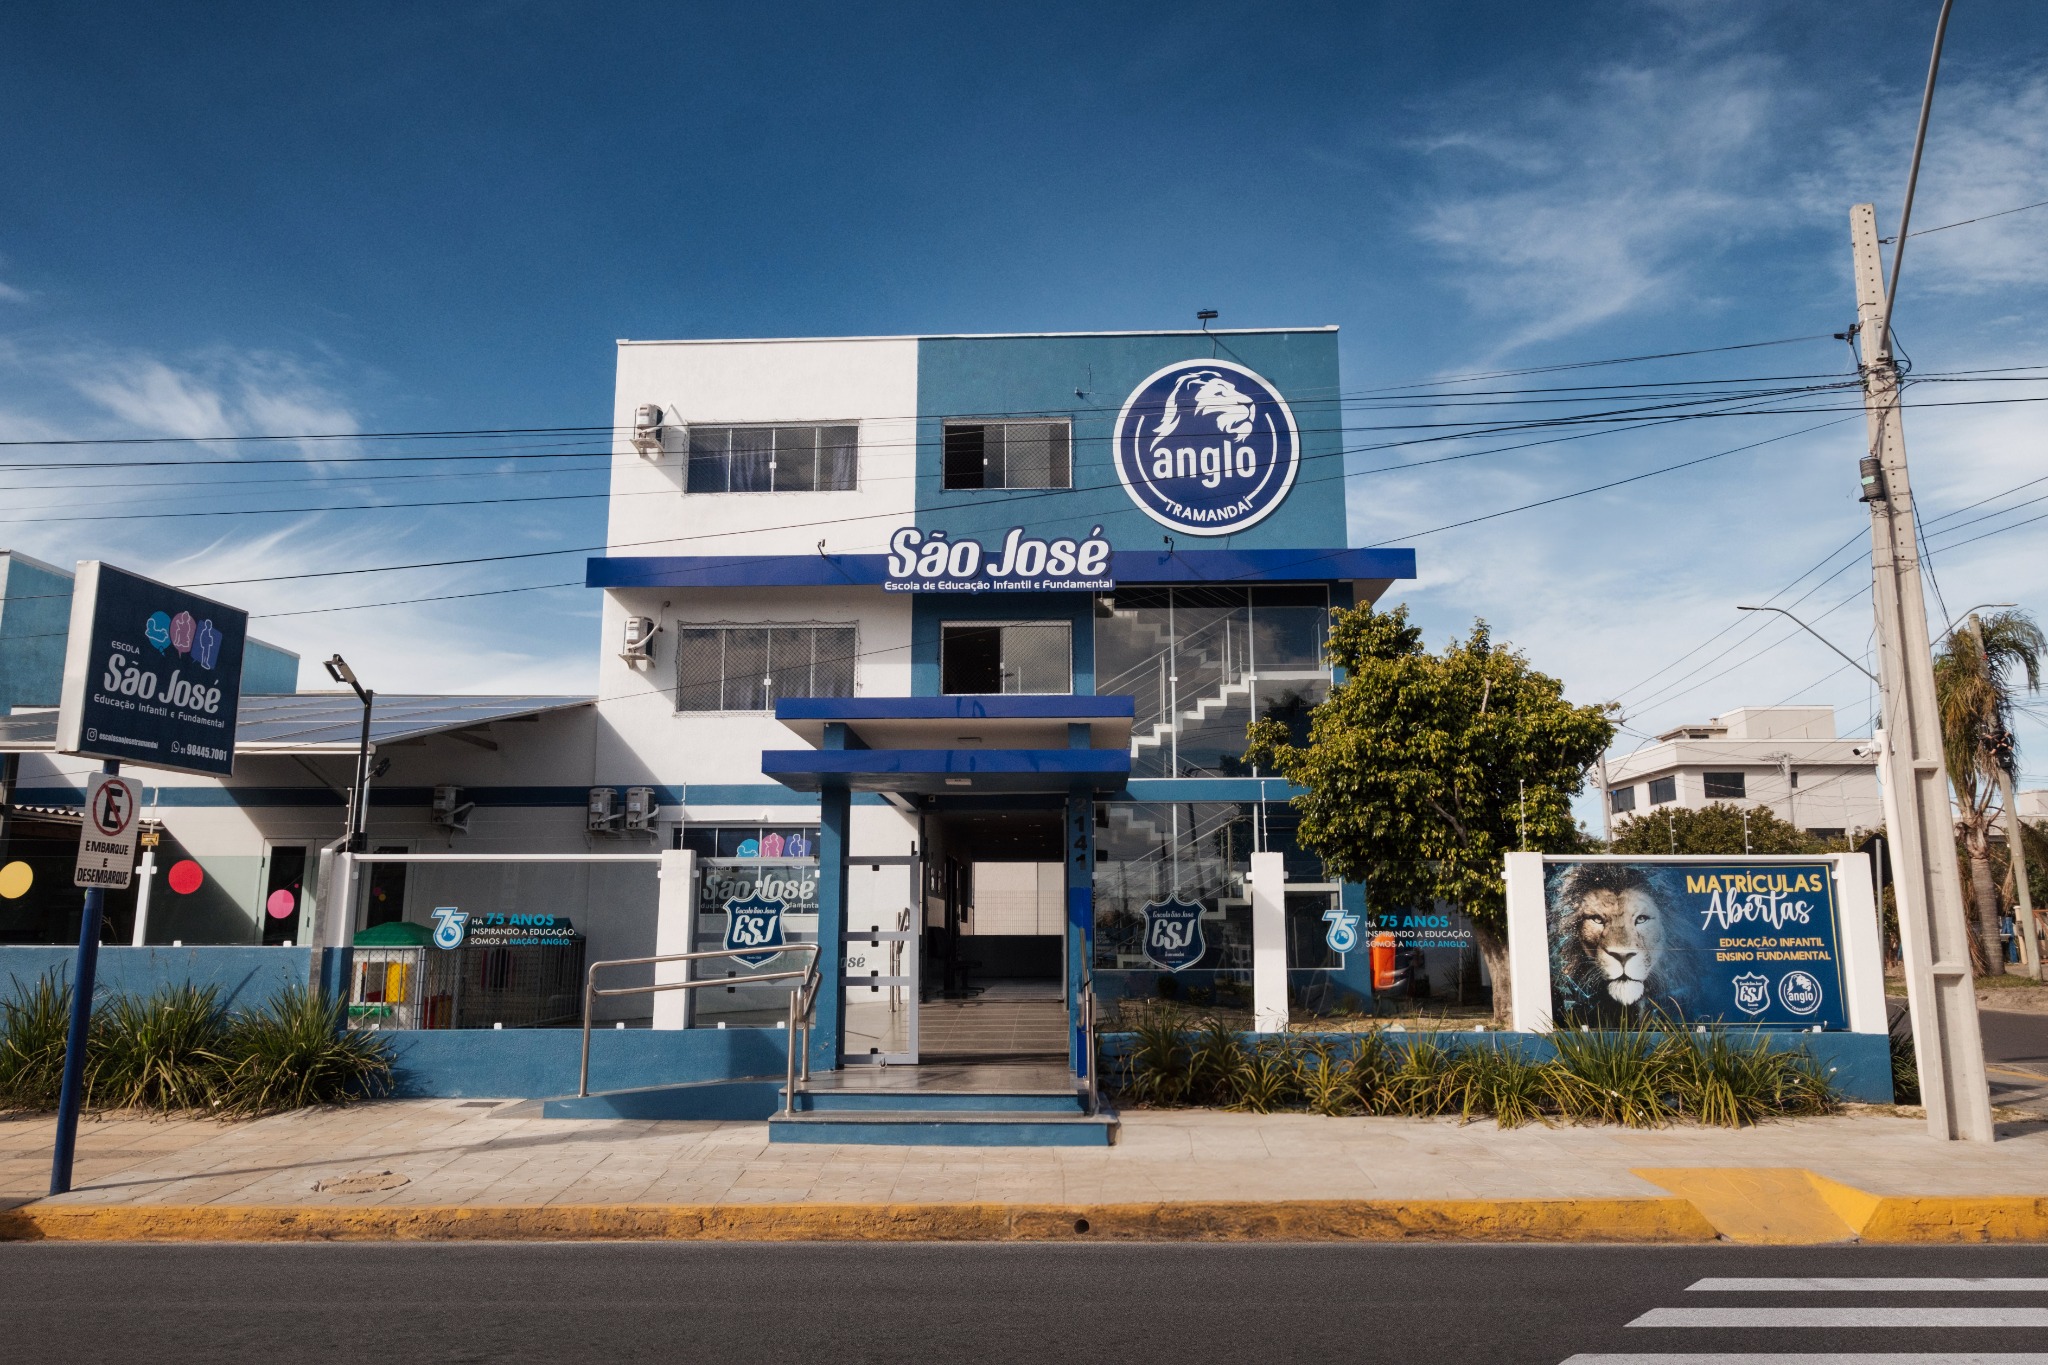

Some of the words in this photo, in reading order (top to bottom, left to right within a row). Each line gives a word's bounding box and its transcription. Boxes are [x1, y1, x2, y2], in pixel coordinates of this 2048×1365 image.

[1152, 439, 1256, 488] anglo
[1166, 495, 1253, 522] TRAMANDAÍ
[888, 529, 980, 577] São
[986, 526, 1109, 577] José
[885, 580, 920, 590] Escola
[922, 580, 936, 590] de
[938, 580, 990, 592] Educação
[993, 579, 1032, 589] Infantil
[1033, 581, 1041, 589] e
[1042, 578, 1113, 589] Fundamental
[111, 640, 140, 655] ESCOLA
[103, 653, 158, 700] São
[158, 669, 222, 714] José
[93, 693, 136, 710] Educação
[138, 702, 168, 717] Infantil
[170, 711, 176, 719] e
[178, 711, 225, 729] Fundamental
[186, 743, 228, 761] 98445.7001
[85, 840, 130, 856] EMBARQUE
[102, 858, 109, 868] E
[76, 867, 129, 885] DESEMBARQUE
[1686, 871, 1823, 894] MATRÍCULAS
[702, 874, 750, 900] São
[759, 873, 816, 900] José
[1700, 887, 1815, 931] Abertas
[471, 917, 484, 926] HÁ
[486, 912, 505, 925] 75
[509, 913, 555, 926] ANOS
[1365, 919, 1377, 928] HÁ
[1379, 915, 1398, 928] 75
[1402, 915, 1449, 928] ANOS
[471, 928, 520, 936] INSPIRANDO
[529, 927, 577, 938] EDUCAÇÃO.
[732, 914, 779, 946] ESJ
[1151, 919, 1196, 950] ESJ
[1365, 930, 1415, 938] INSPIRANDO
[1425, 928, 1473, 940] EDUCAÇÃO.
[509, 936, 539, 947] NAÇÃO
[541, 938, 572, 946] ANGLO.
[1365, 940, 1396, 948] SOMOS
[1397, 940, 1404, 948] A
[1405, 938, 1436, 950] NAÇÃO
[1437, 940, 1469, 948] ANGLO.
[1719, 936, 1777, 948] EDUCAÇÃO
[1779, 937, 1825, 947] INFANTIL
[1716, 951, 1754, 962] ENSINO
[1756, 950, 1831, 961] FUNDAMENTAL
[1740, 985, 1763, 1003] ESJ
[1788, 992, 1813, 1004] anglo
